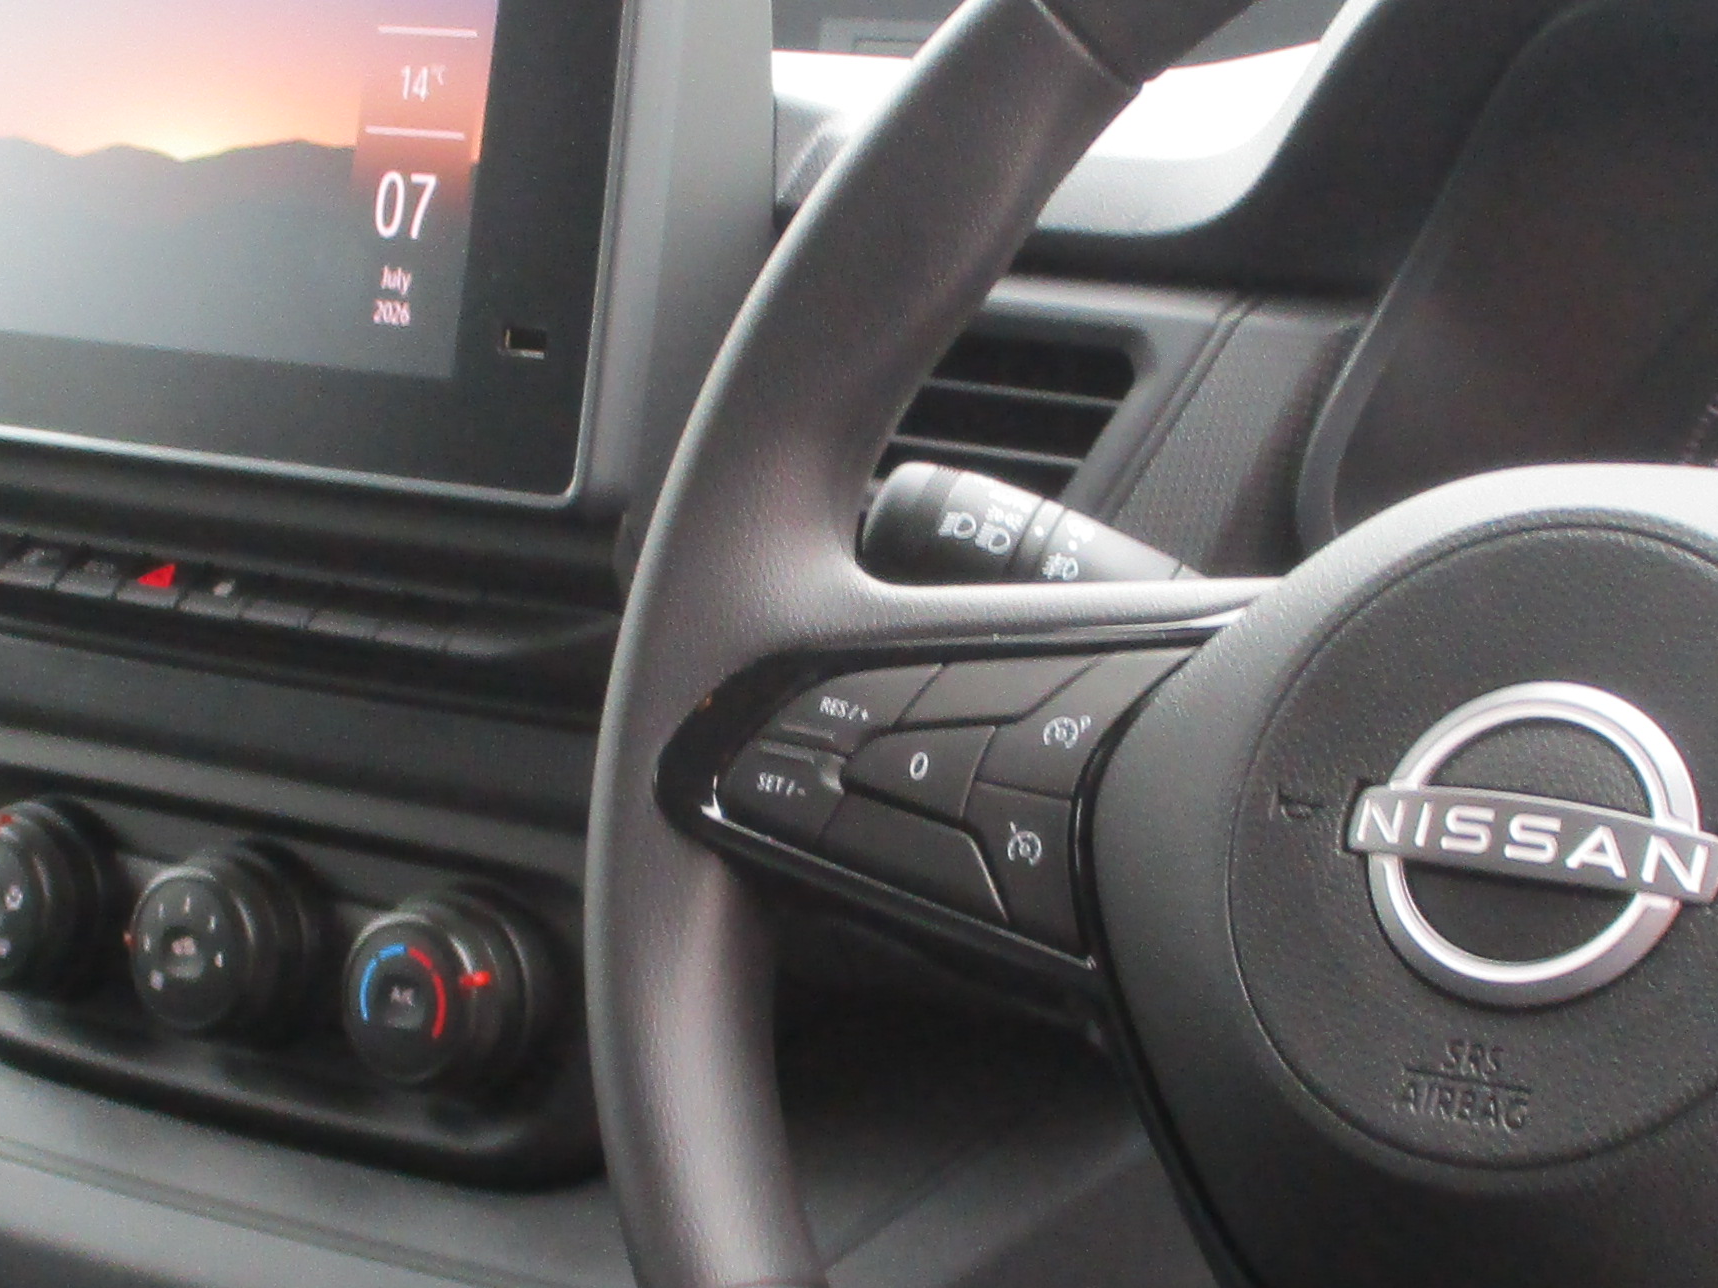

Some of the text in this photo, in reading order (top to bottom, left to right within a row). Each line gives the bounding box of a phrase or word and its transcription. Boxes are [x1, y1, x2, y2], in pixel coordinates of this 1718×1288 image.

[375, 171, 438, 239] 07
[380, 265, 412, 295] July
[373, 299, 411, 327] 2026
[1355, 800, 1710, 895] NISSAN
[1438, 1037, 1506, 1079] SRS
[1391, 1081, 1532, 1132] AIRBAG
